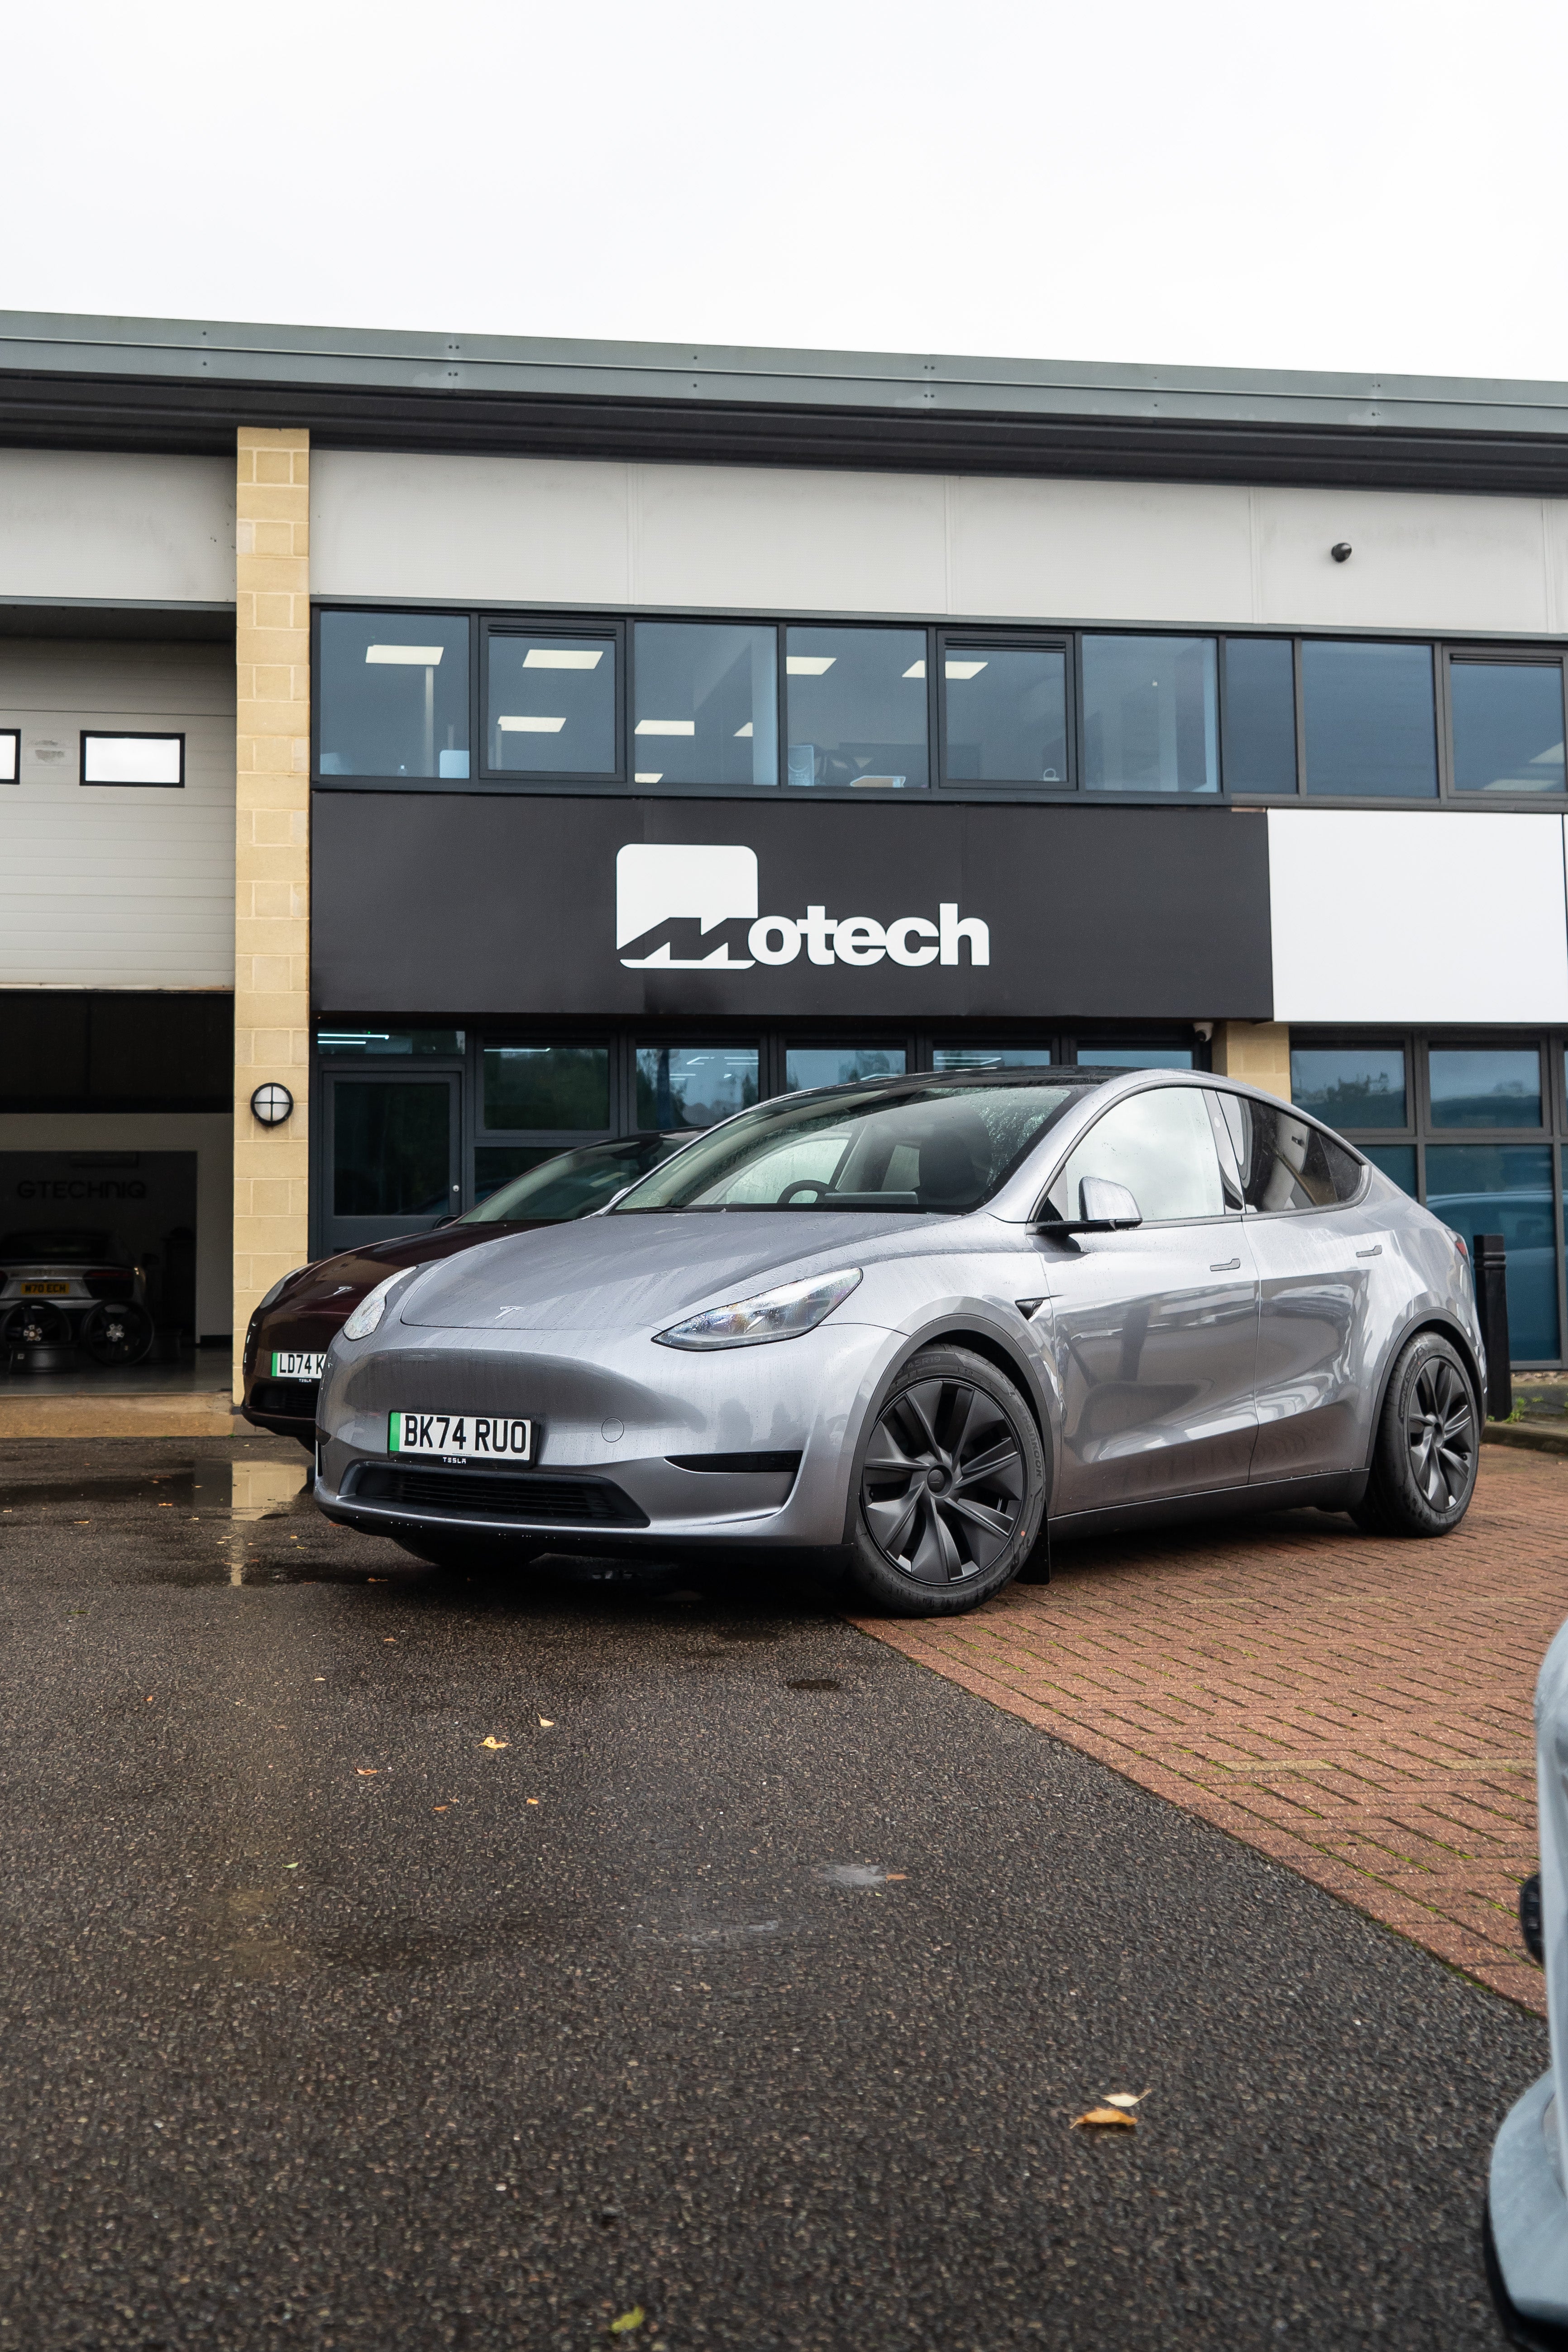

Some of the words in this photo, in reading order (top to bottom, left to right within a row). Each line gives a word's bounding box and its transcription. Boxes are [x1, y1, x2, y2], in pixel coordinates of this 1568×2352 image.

[616, 843, 990, 970] Motech
[279, 1353, 312, 1374] LD74
[404, 1415, 467, 1450] BK74
[475, 1419, 526, 1453] RUO
[442, 1456, 467, 1464] TESLA
